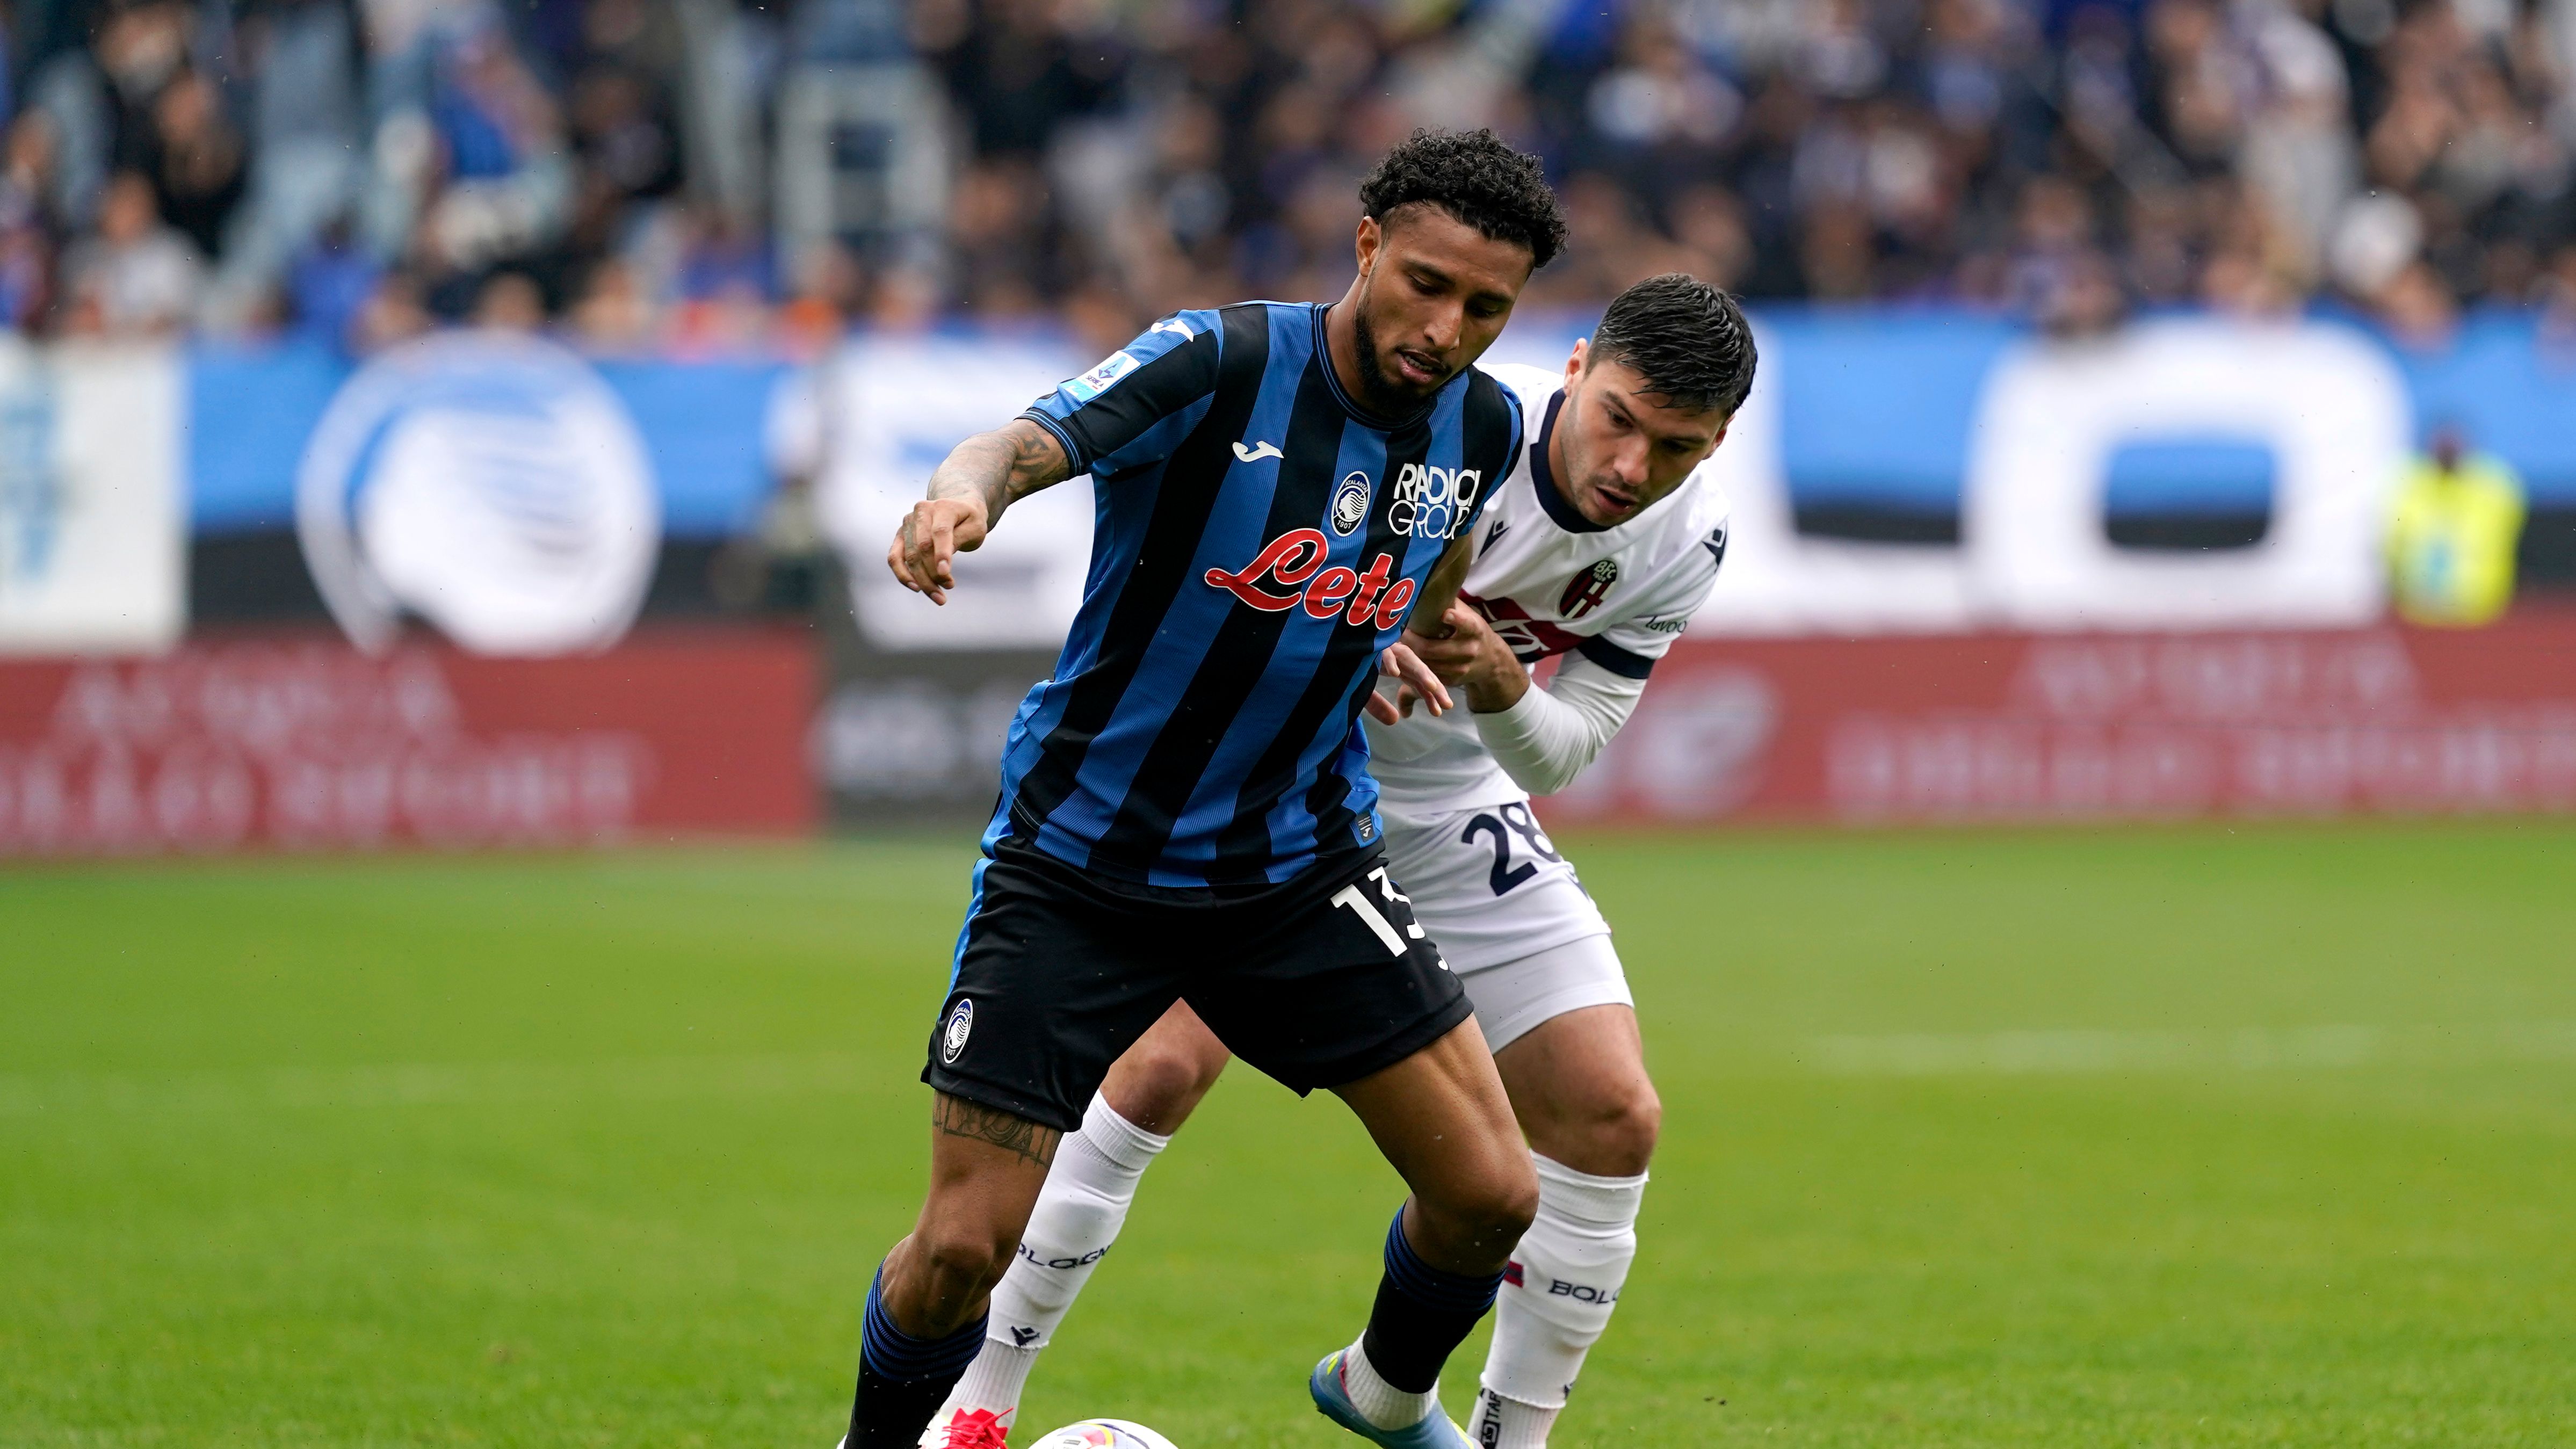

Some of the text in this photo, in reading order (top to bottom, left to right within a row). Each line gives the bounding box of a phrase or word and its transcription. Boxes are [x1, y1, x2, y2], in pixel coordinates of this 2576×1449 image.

[1345, 480, 1367, 491] ATALANTA
[1393, 463, 1481, 506] RADICI
[1337, 519, 1352, 529] 1907
[1388, 499, 1470, 540] GROUP
[1204, 527, 1415, 631] Lete
[1594, 561, 1616, 578] BFC
[1461, 802, 1561, 896] 28
